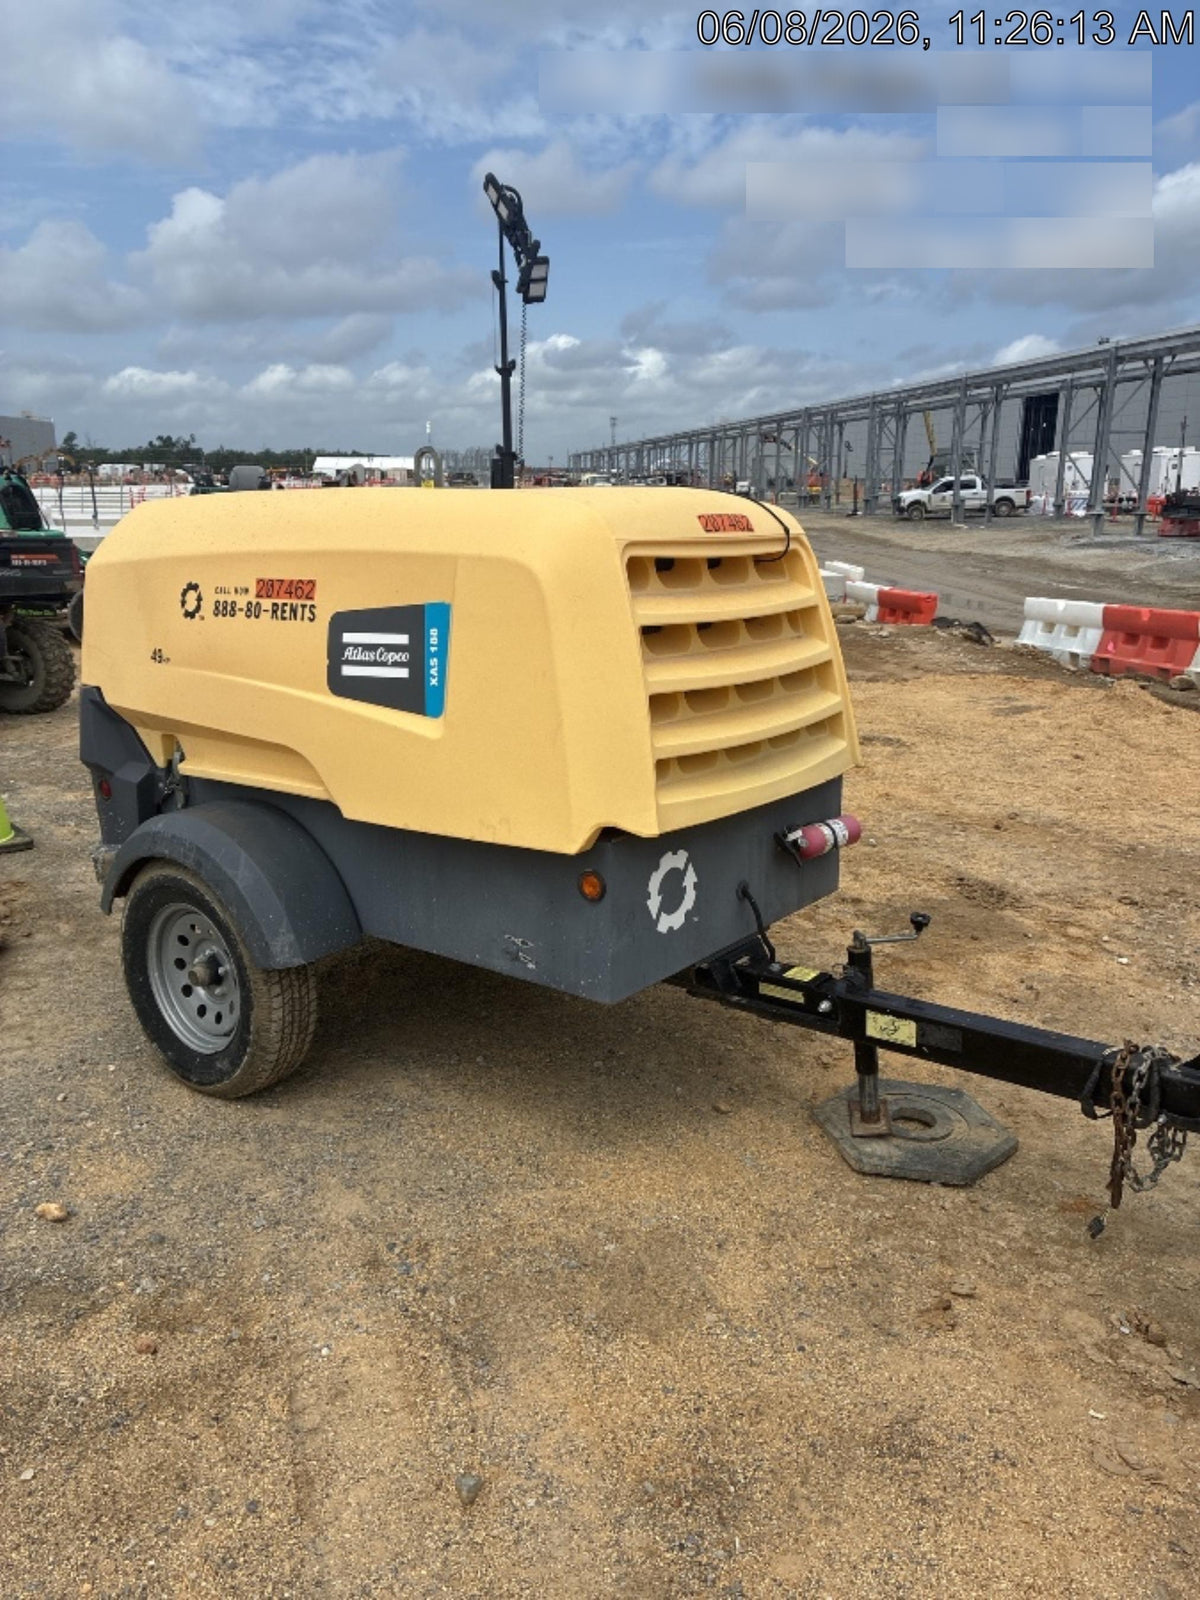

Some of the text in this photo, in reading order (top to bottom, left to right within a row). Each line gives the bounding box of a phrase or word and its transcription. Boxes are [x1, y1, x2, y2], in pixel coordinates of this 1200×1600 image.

[256, 579, 316, 600] 207462
[213, 600, 316, 622] 888-80-RENTS
[342, 647, 409, 665] Atlas Copco
[429, 658, 438, 687] XAS
